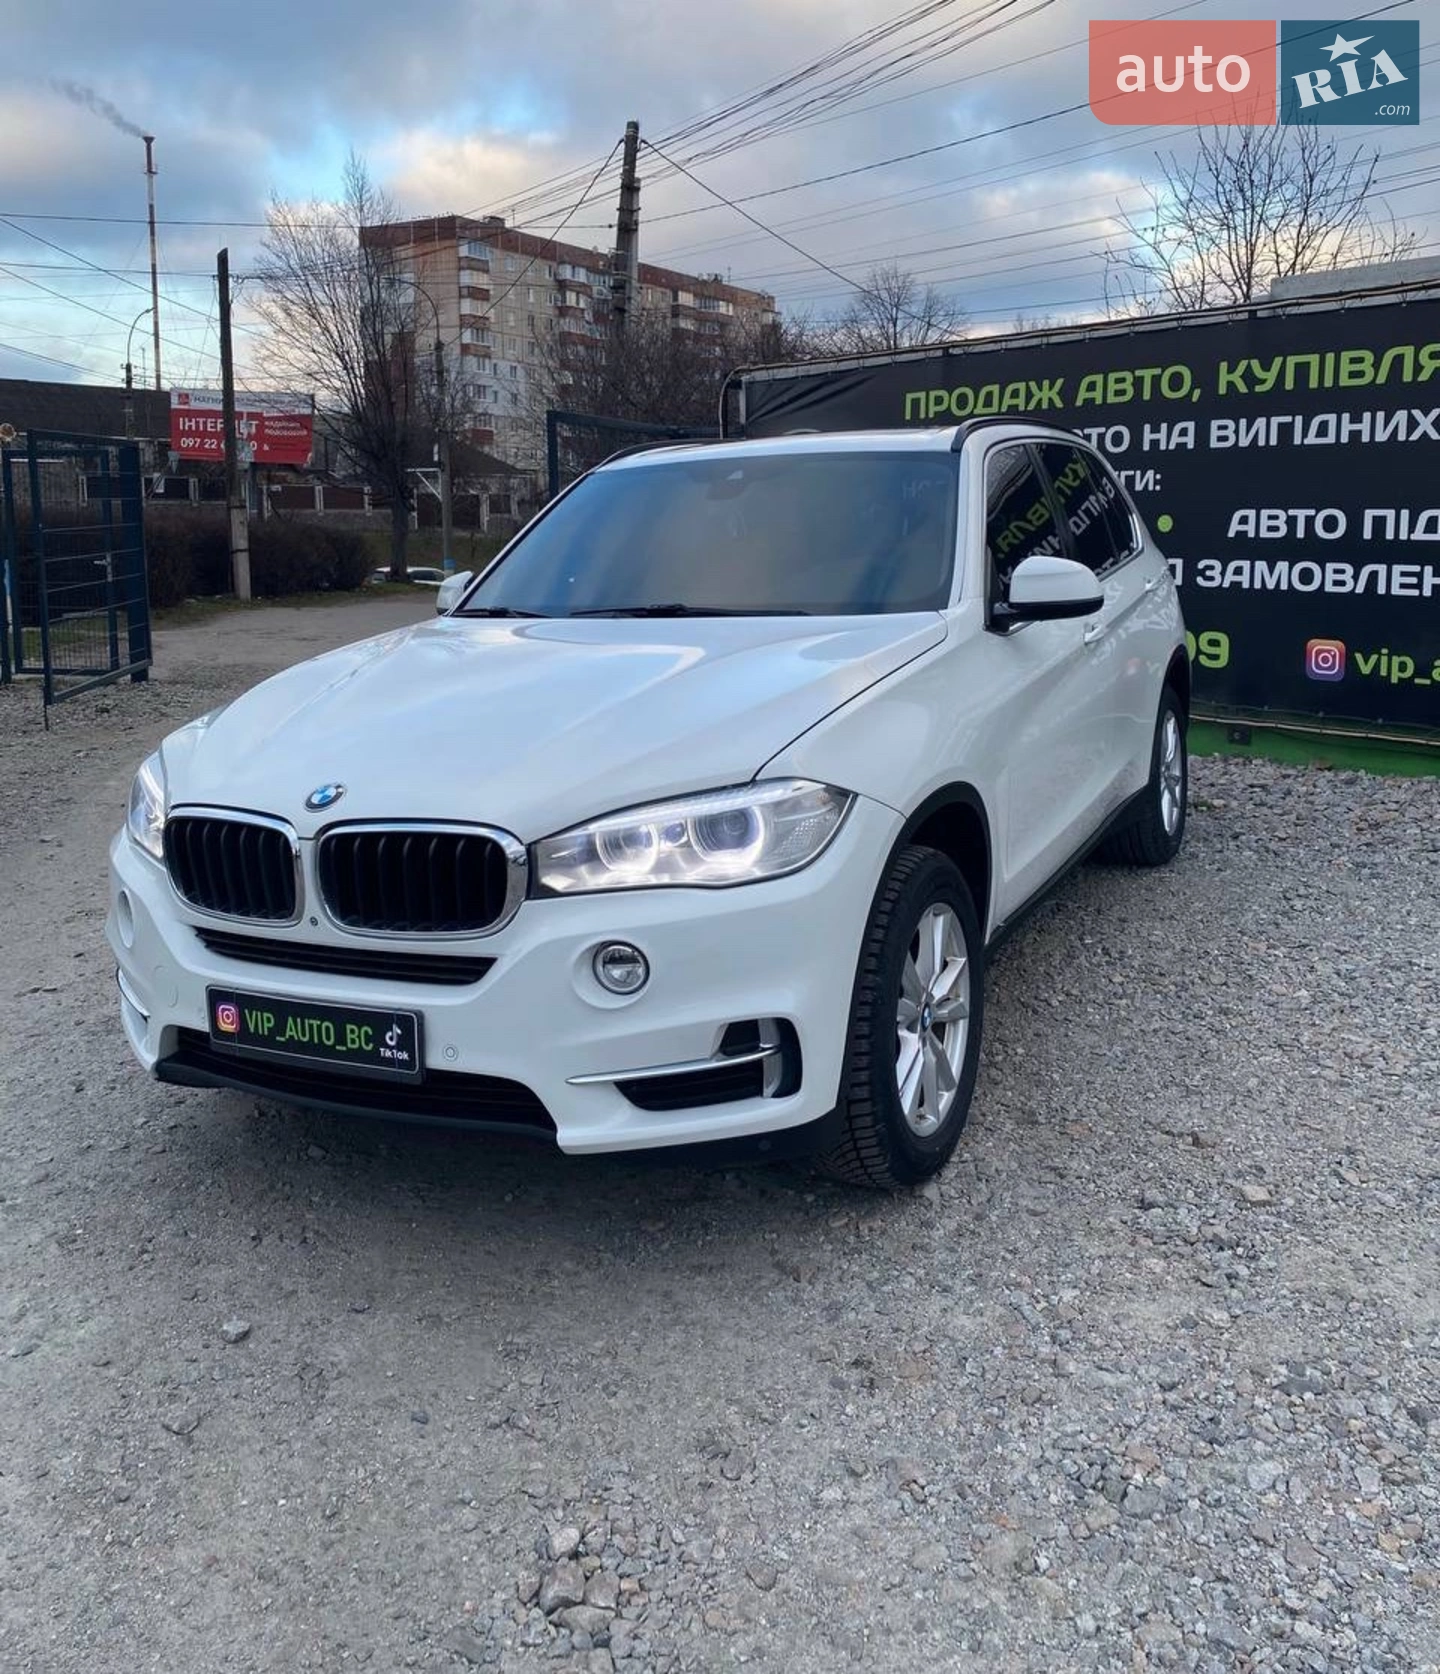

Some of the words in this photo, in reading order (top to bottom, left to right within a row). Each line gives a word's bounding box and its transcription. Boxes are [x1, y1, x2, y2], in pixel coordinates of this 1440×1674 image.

[904, 378, 1065, 421] ПРОДАЖ
[1075, 364, 1201, 406] АВТО,
[1218, 343, 1440, 395] КУПІВЛЯ
[180, 437, 201, 448] 097
[204, 438, 217, 449] 22
[1073, 425, 1130, 453] ТО
[1142, 421, 1195, 452] НА
[1209, 408, 1440, 449] ВИГІДНИХ
[1114, 469, 1161, 491] ГИ:
[1227, 508, 1347, 539] АВТО
[1362, 508, 1440, 541] ПІД
[379, 1048, 410, 1061] TikTok
